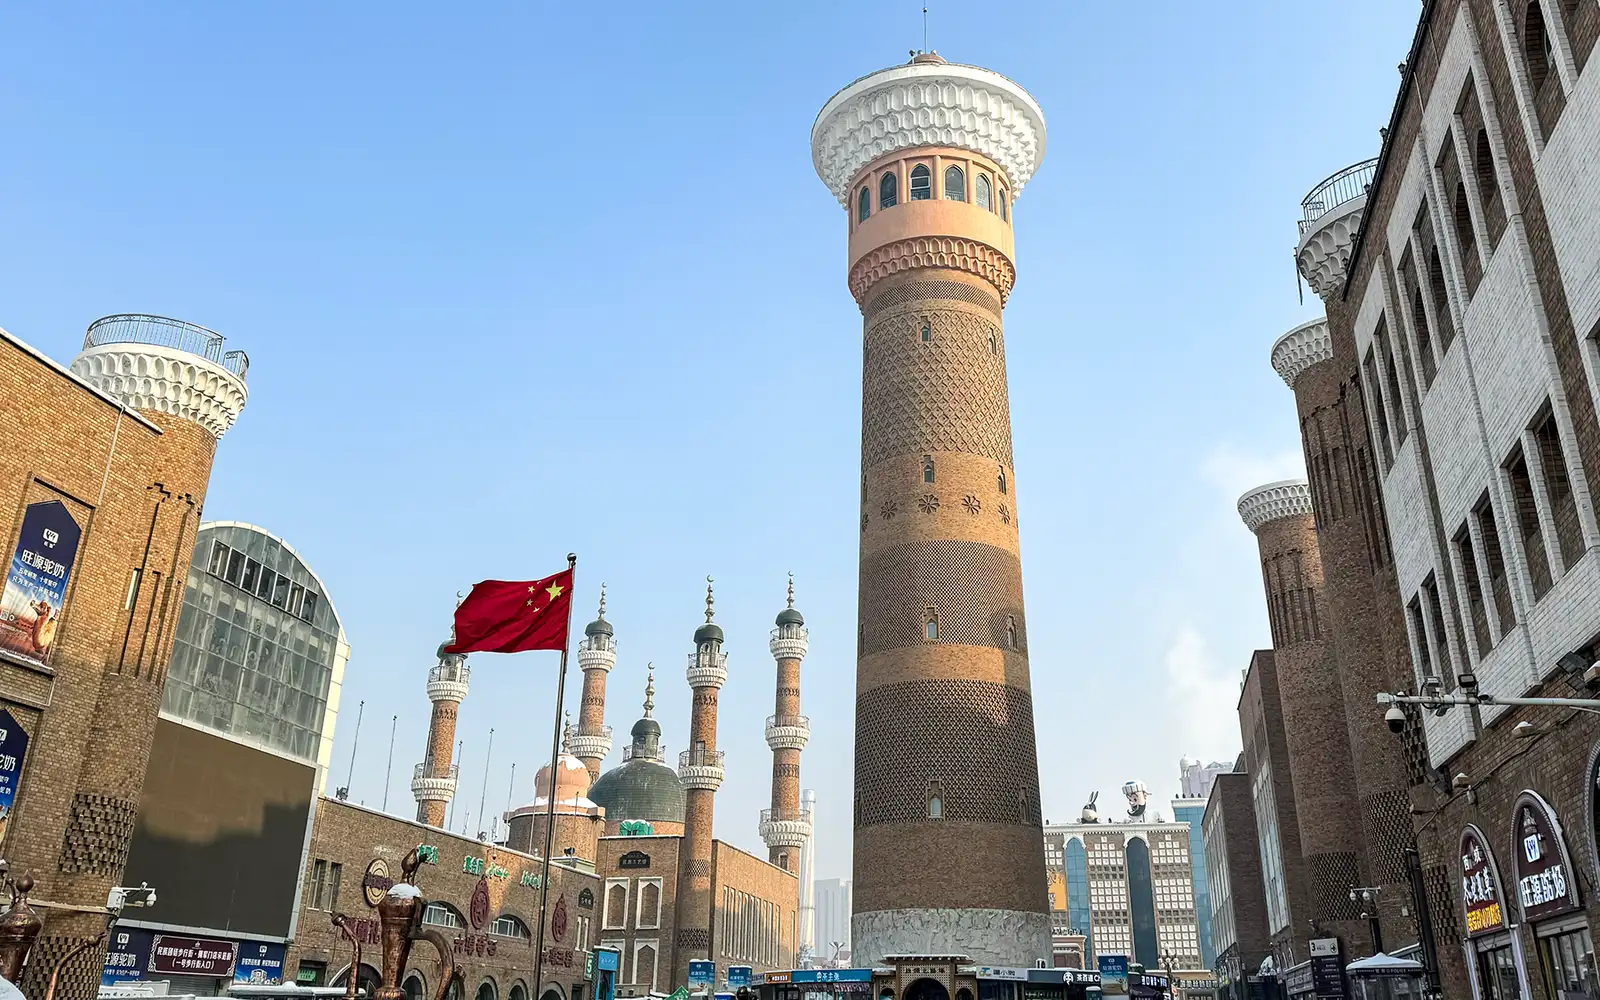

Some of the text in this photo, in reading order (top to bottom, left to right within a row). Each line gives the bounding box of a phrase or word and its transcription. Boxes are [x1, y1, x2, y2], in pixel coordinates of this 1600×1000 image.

[21, 549, 65, 579] 旺源驼奶
[1311, 942, 1316, 952] 3
[586, 958, 593, 973] 5
